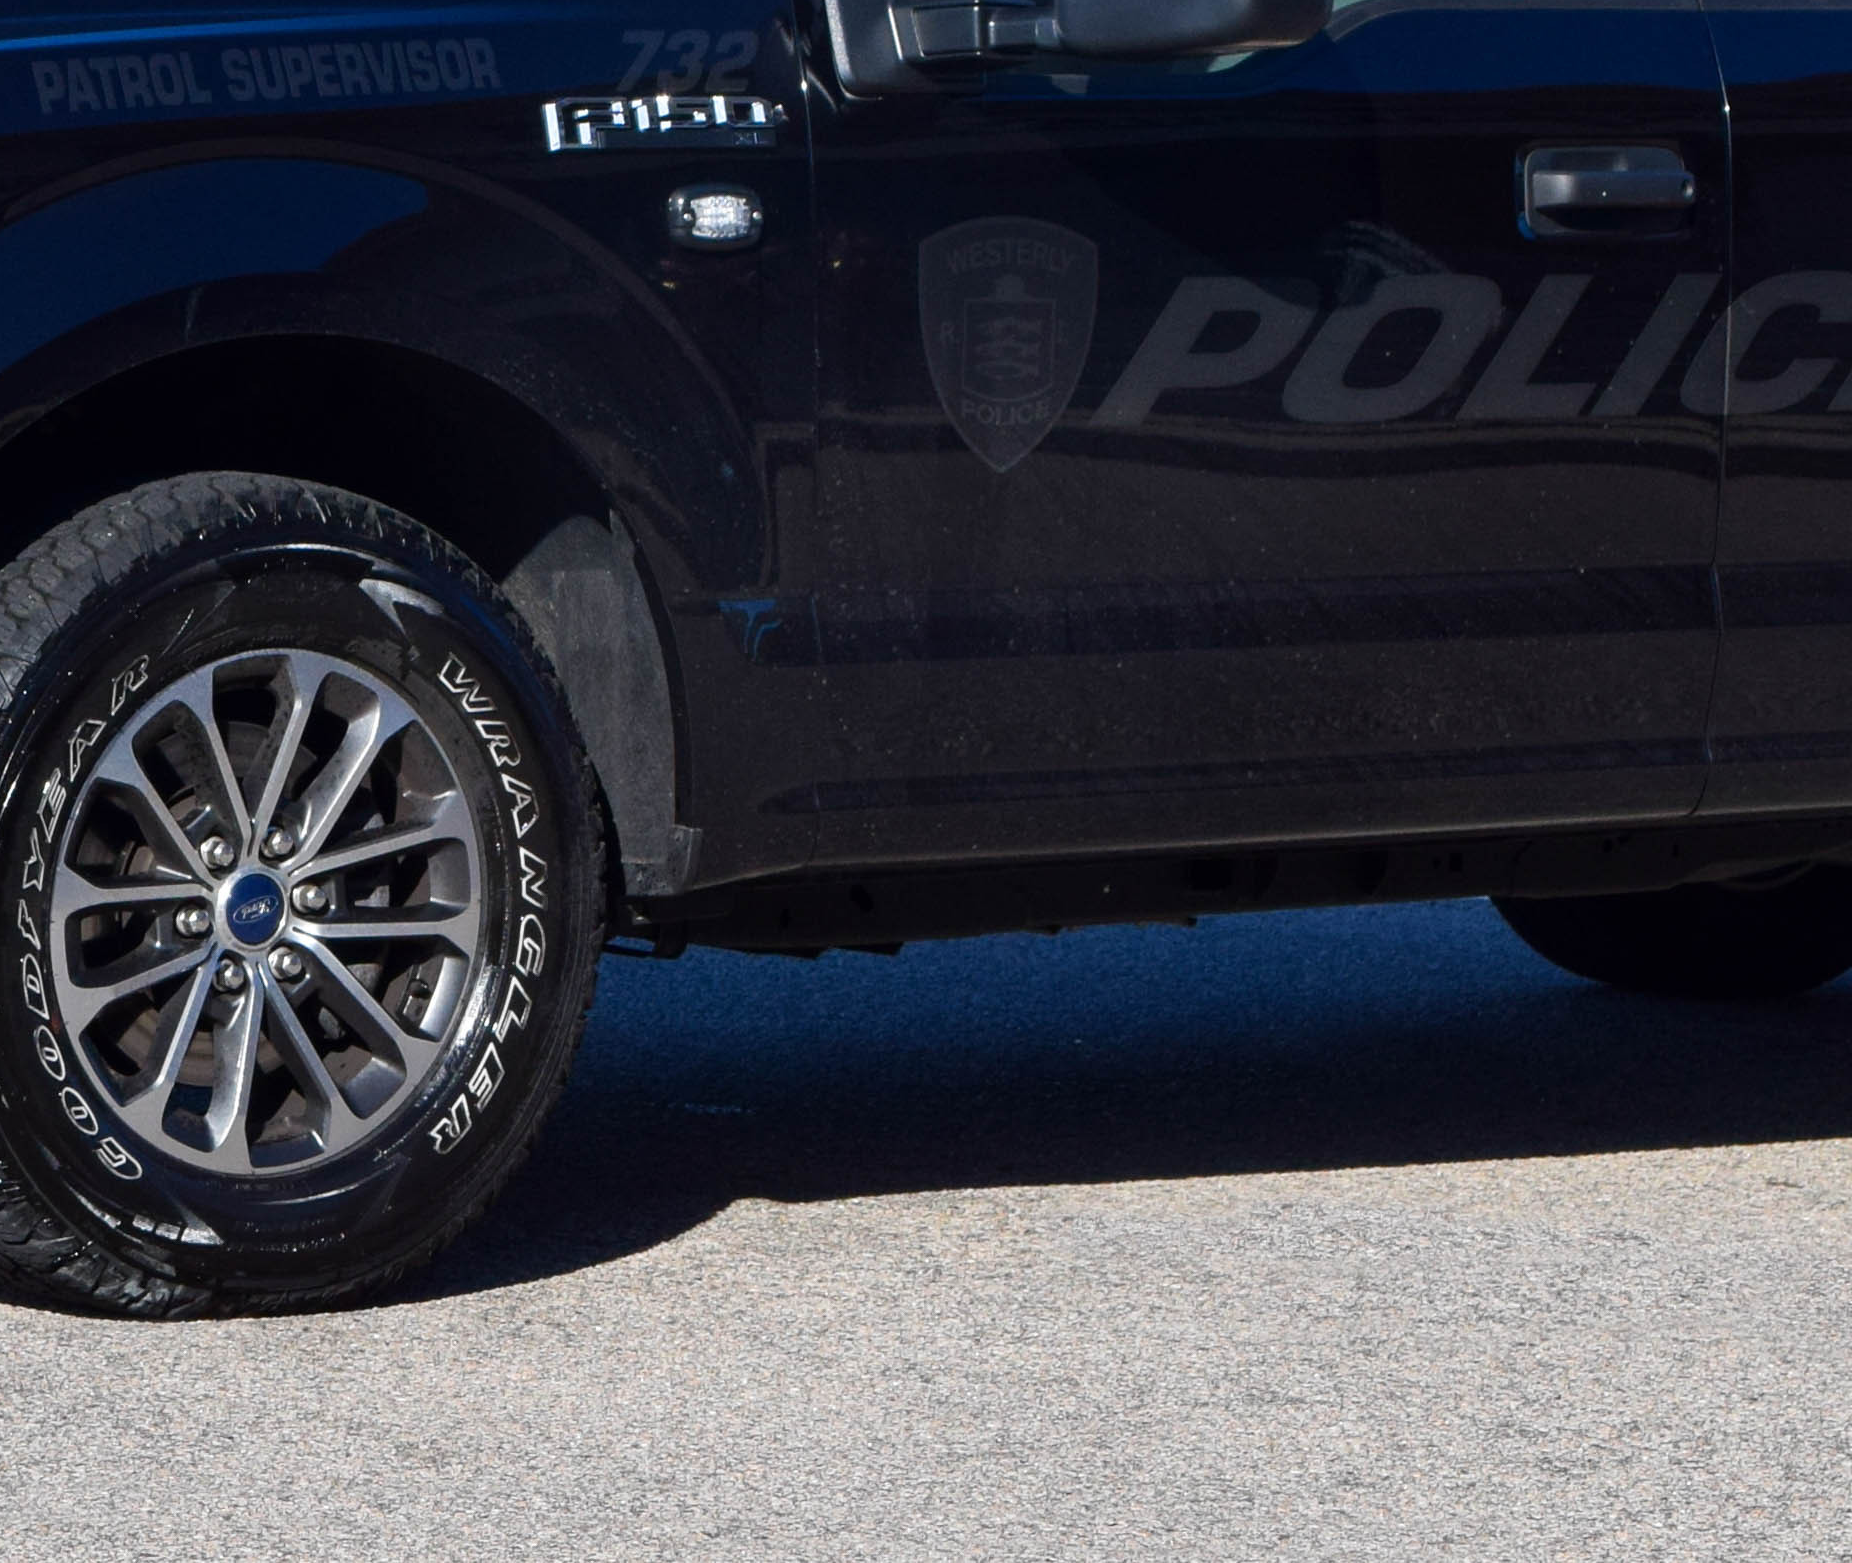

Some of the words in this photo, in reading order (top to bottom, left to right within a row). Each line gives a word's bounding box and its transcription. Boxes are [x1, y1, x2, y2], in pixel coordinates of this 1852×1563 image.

[31, 51, 212, 116] PATROL
[225, 37, 502, 102] SUPERVISOR
[615, 29, 759, 93] 732
[946, 237, 1084, 277] WESTERLY
[960, 399, 1051, 426] POLICE
[20, 653, 149, 1180] GOODYEAR
[429, 652, 546, 1154] WRANGLER
